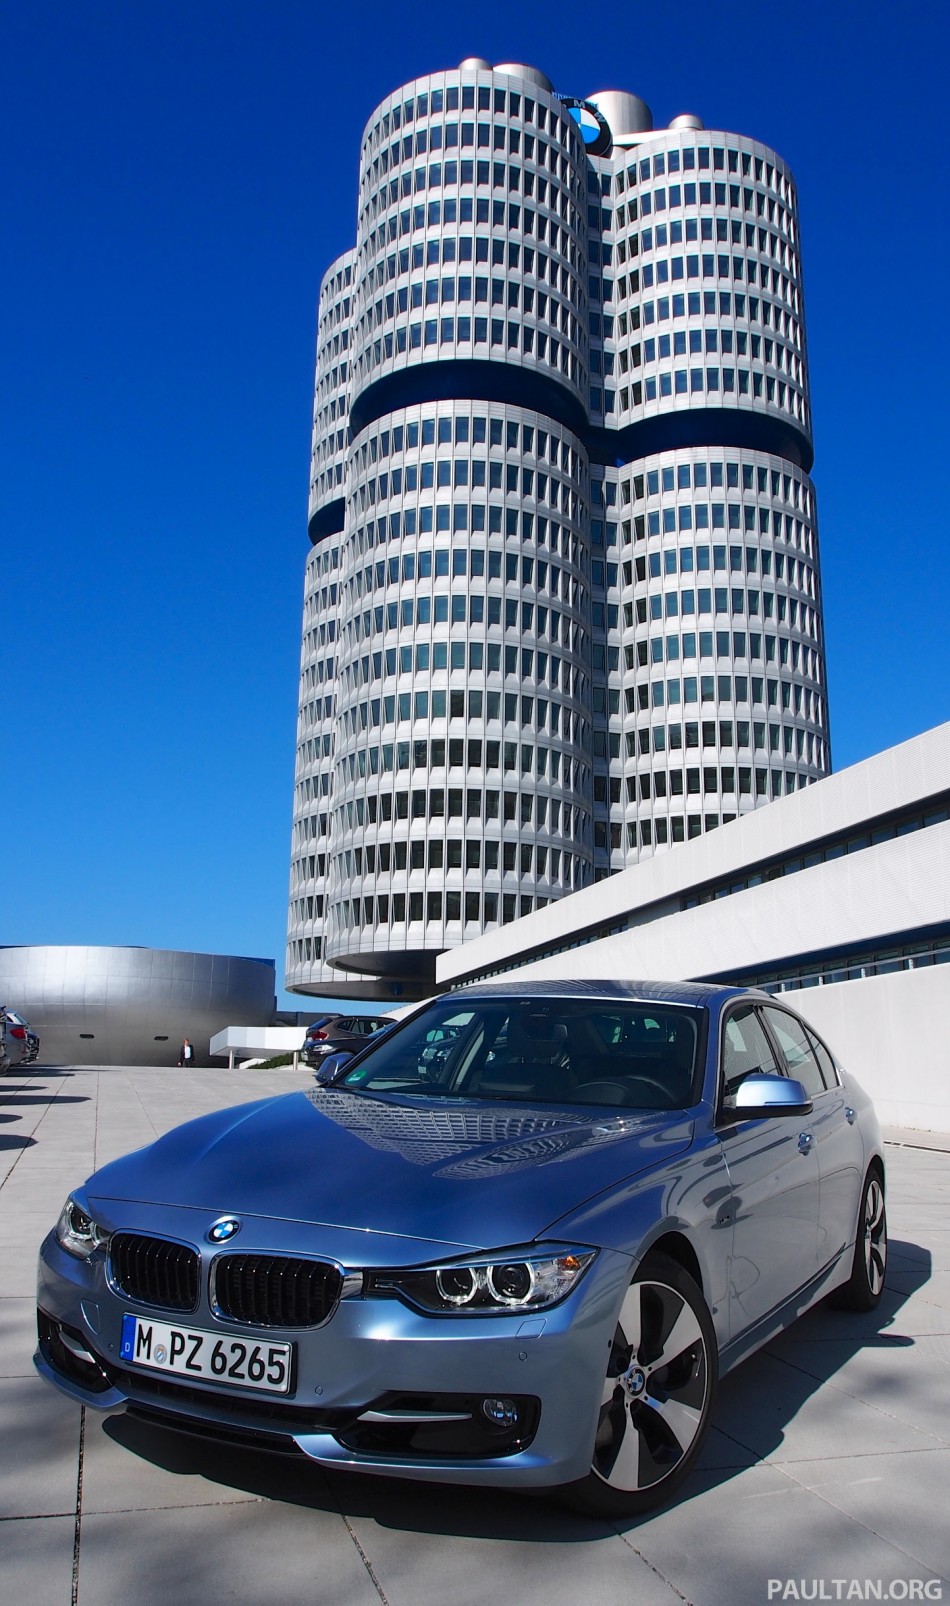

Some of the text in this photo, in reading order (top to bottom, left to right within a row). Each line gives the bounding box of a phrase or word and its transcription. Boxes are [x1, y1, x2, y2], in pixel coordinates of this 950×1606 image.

[124, 1342, 131, 1352] D
[136, 1323, 287, 1385] M PZ 6265
